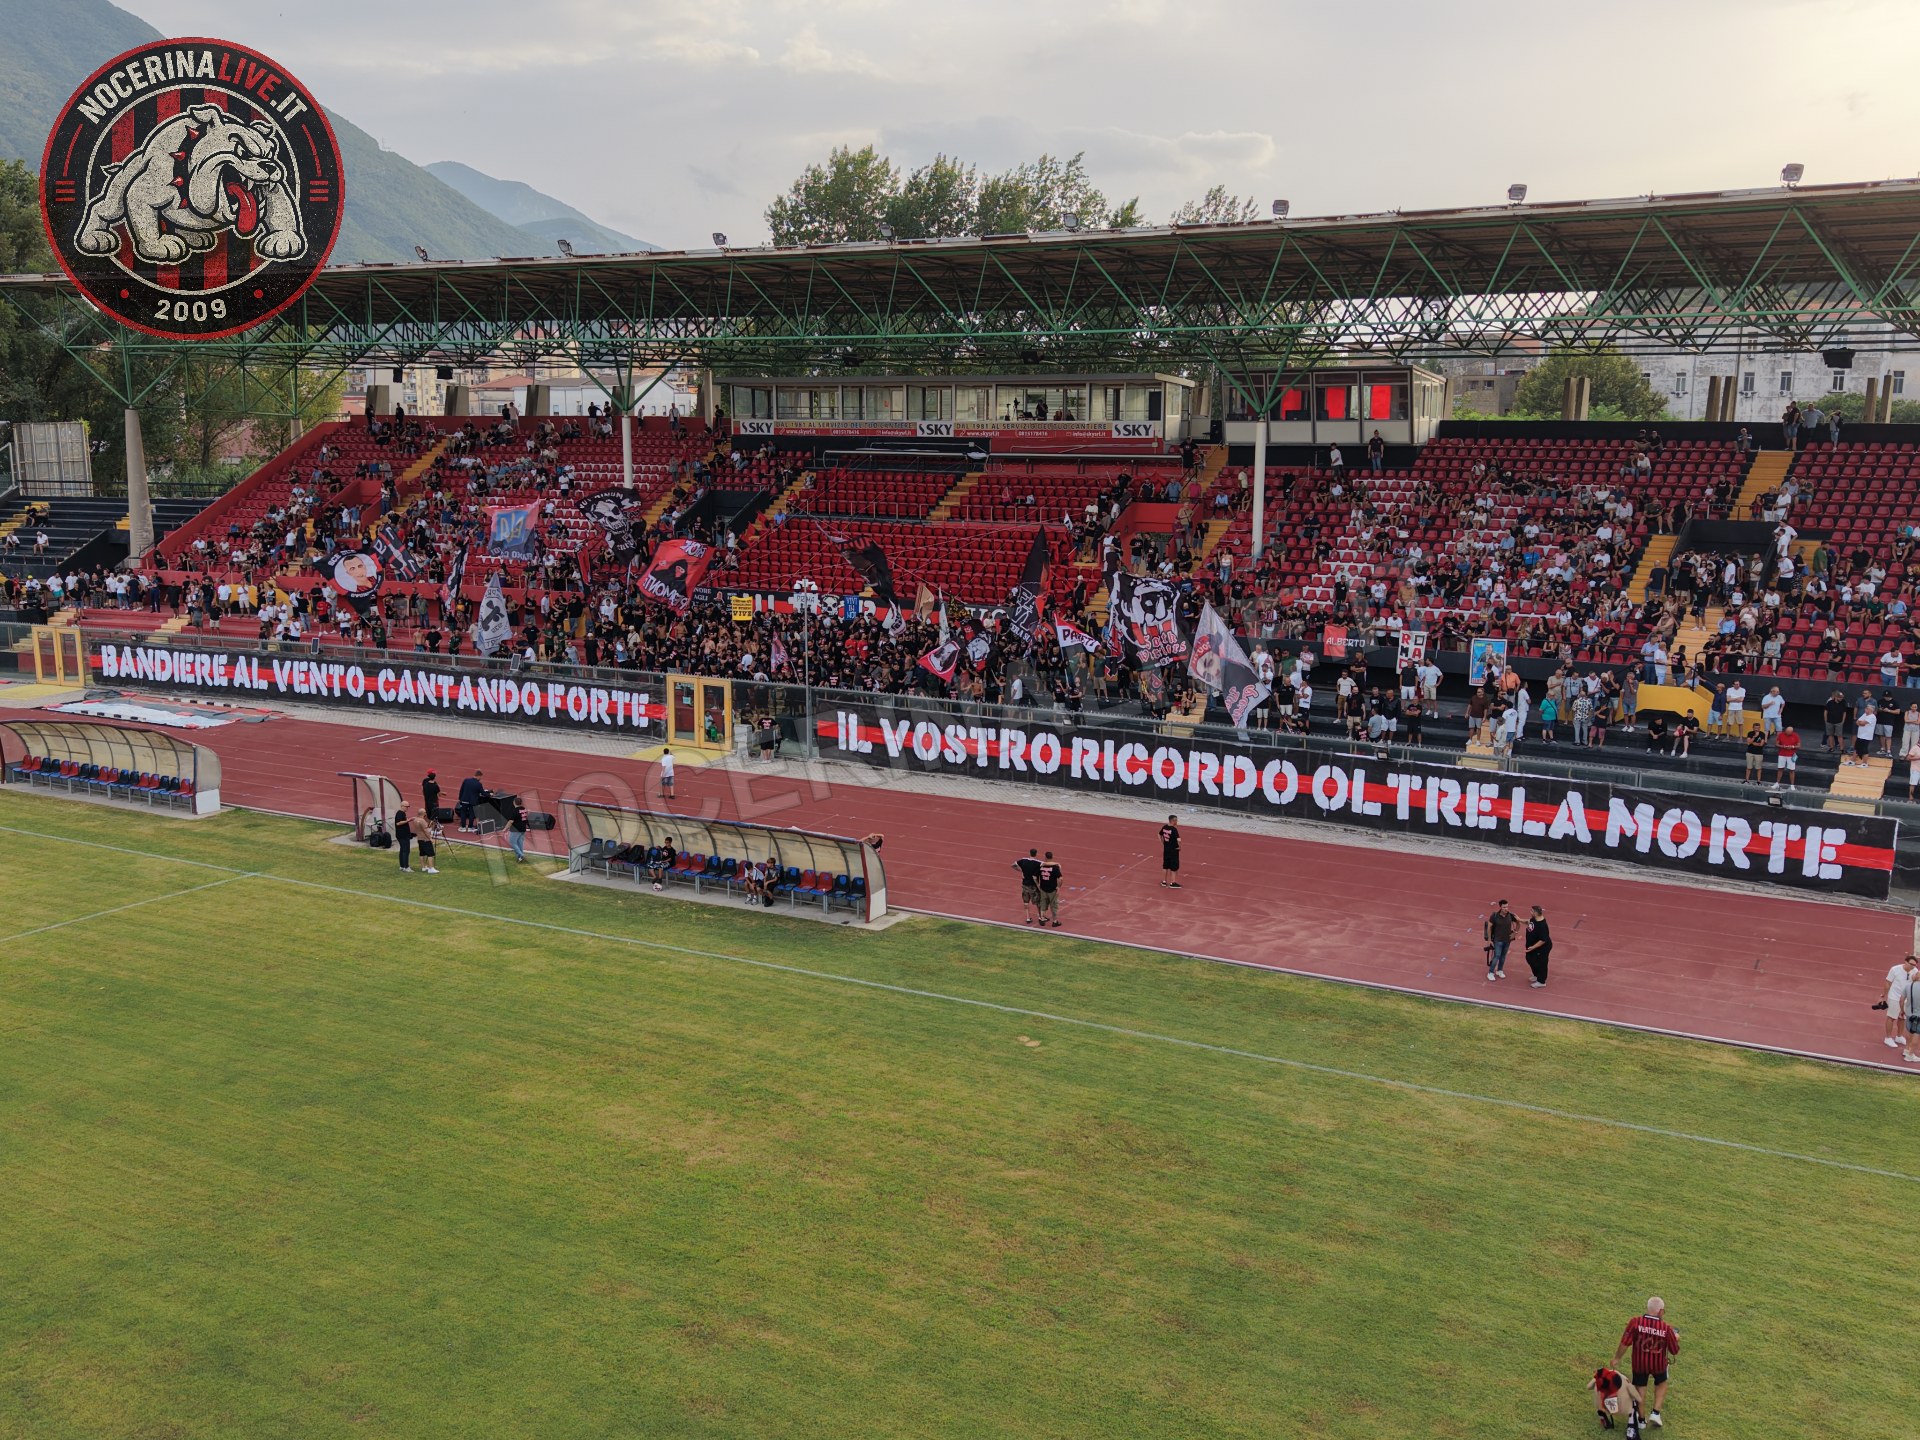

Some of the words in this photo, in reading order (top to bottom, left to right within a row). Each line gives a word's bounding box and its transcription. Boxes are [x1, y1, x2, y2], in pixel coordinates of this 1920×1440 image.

[748, 422, 773, 433] SKY
[926, 424, 953, 436] SKY
[1122, 424, 1152, 436] SKY
[1325, 637, 1366, 648] ALBERTO
[101, 645, 229, 687] BANDIERE
[233, 655, 269, 691] AL
[377, 669, 542, 716] CANTANDO
[547, 683, 650, 728] FORTE
[837, 711, 873, 754] IL
[879, 718, 1062, 774] VOSTRO
[1070, 737, 1299, 804] RICORDO
[1311, 765, 1499, 829] OLTRE
[1508, 786, 1592, 843] LA
[1604, 798, 1847, 880] MORTE
[1637, 1325, 1667, 1338] VERTICALE
